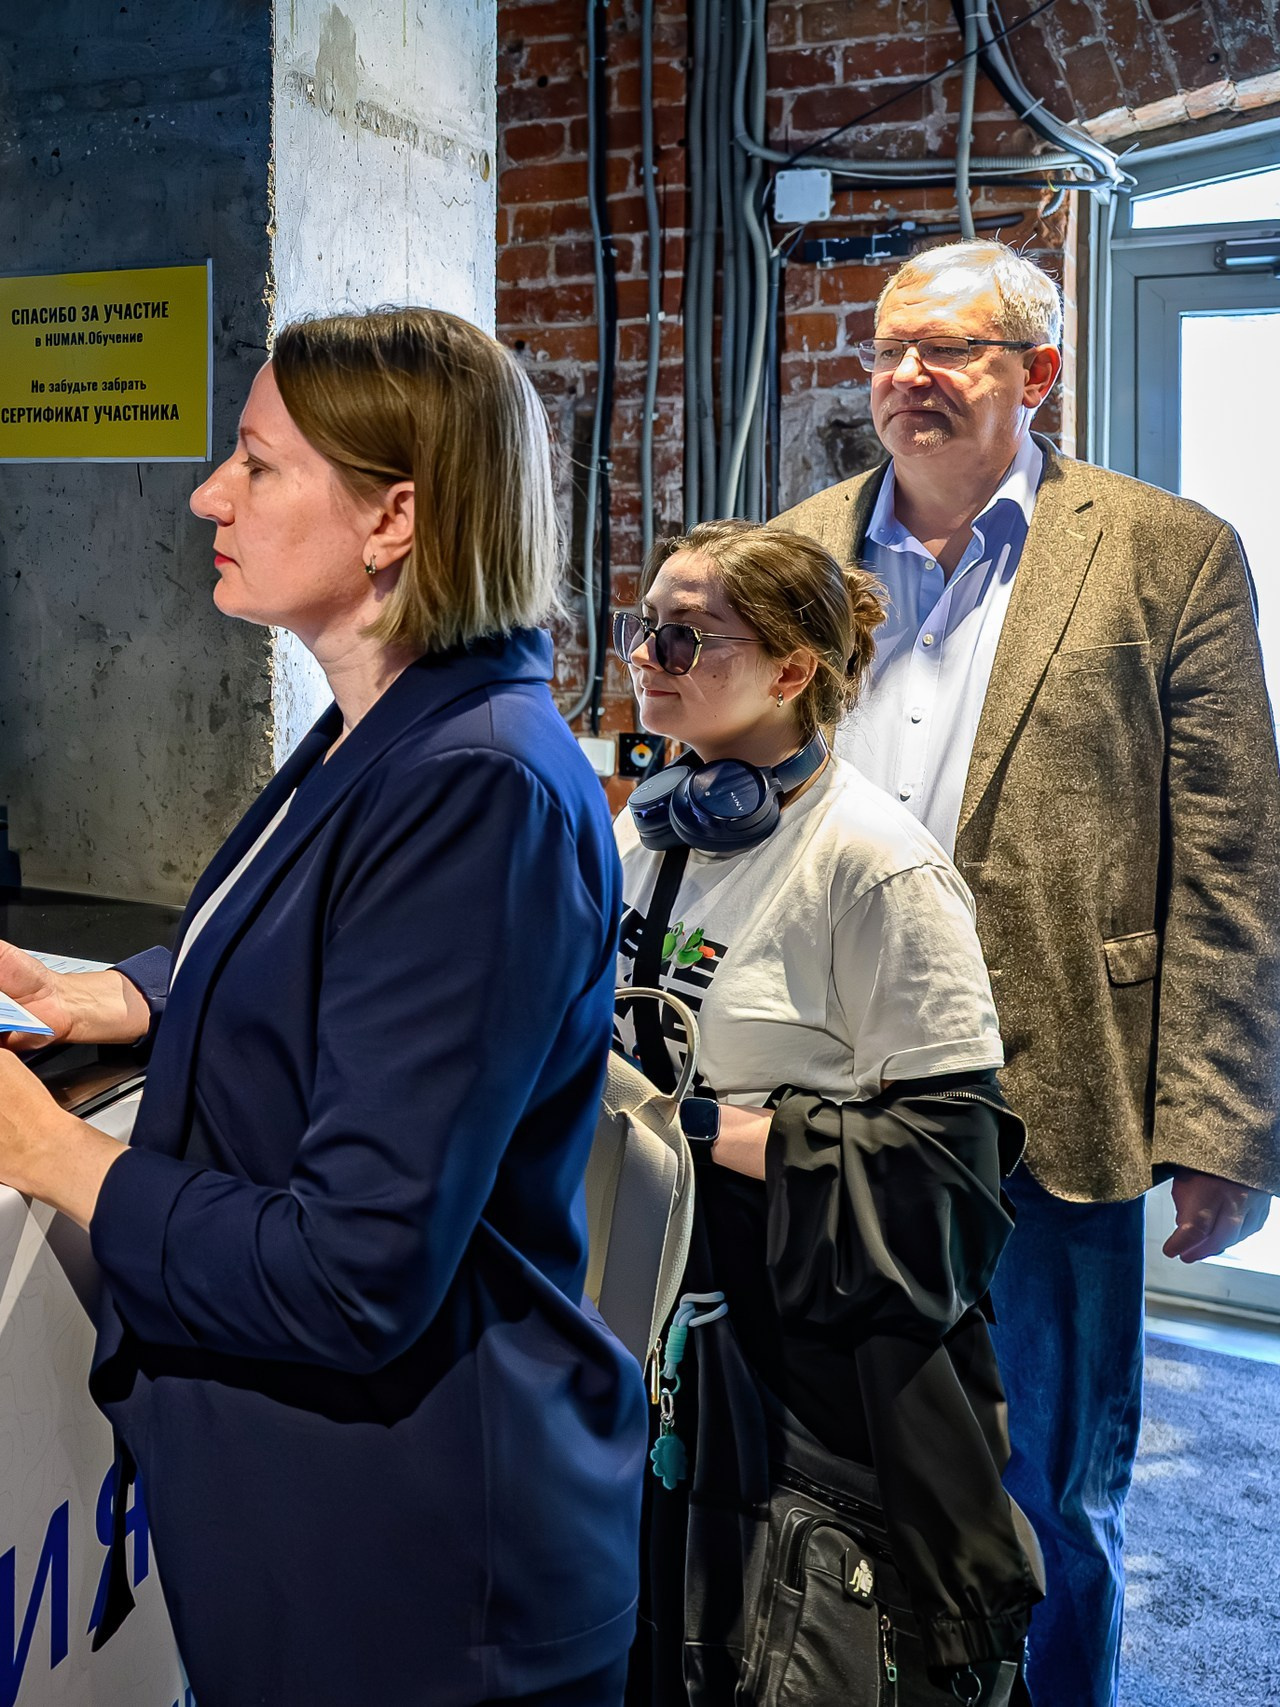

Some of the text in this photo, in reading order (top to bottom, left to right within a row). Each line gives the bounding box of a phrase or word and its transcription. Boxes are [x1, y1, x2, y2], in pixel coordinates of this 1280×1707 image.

[11, 301, 169, 325] СПАСИБО ЗА УЧАСТИЕ
[34, 331, 143, 347] в HUMAN.Обучение
[31, 376, 147, 394] Не забудьте забрать
[1, 403, 180, 424] СЕРТИФИКАТ УЧАСТНИКА
